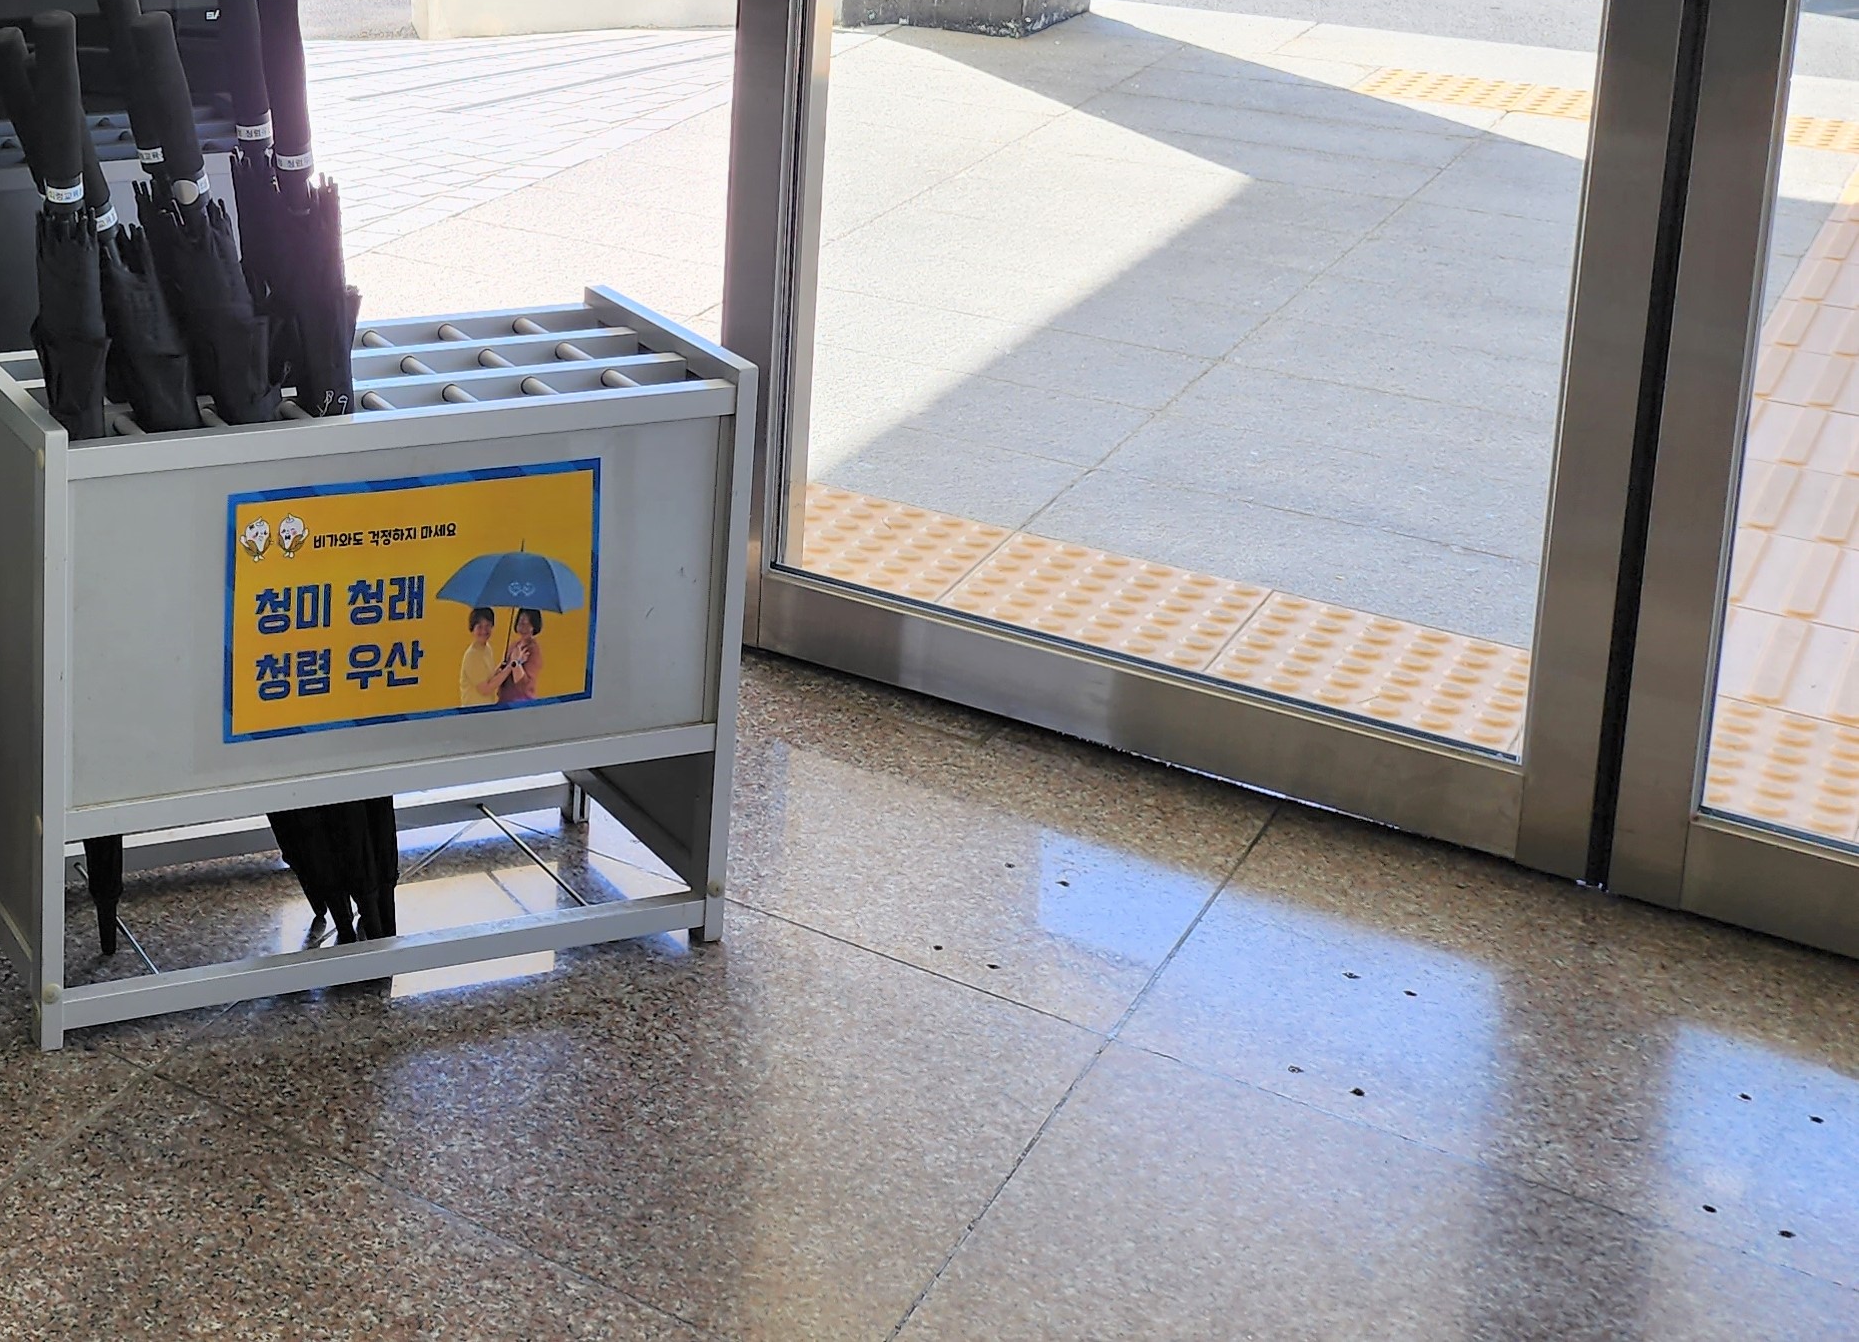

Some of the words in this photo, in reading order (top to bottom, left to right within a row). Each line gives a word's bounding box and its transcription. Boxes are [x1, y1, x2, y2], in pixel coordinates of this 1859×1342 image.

[313, 531, 364, 549] 비가와도
[368, 526, 417, 547] 걱정하지
[421, 522, 457, 540] 마세요
[255, 583, 331, 635] 청미
[347, 575, 425, 627] 청래
[255, 648, 332, 702] 청렴
[346, 640, 424, 690] 우산
